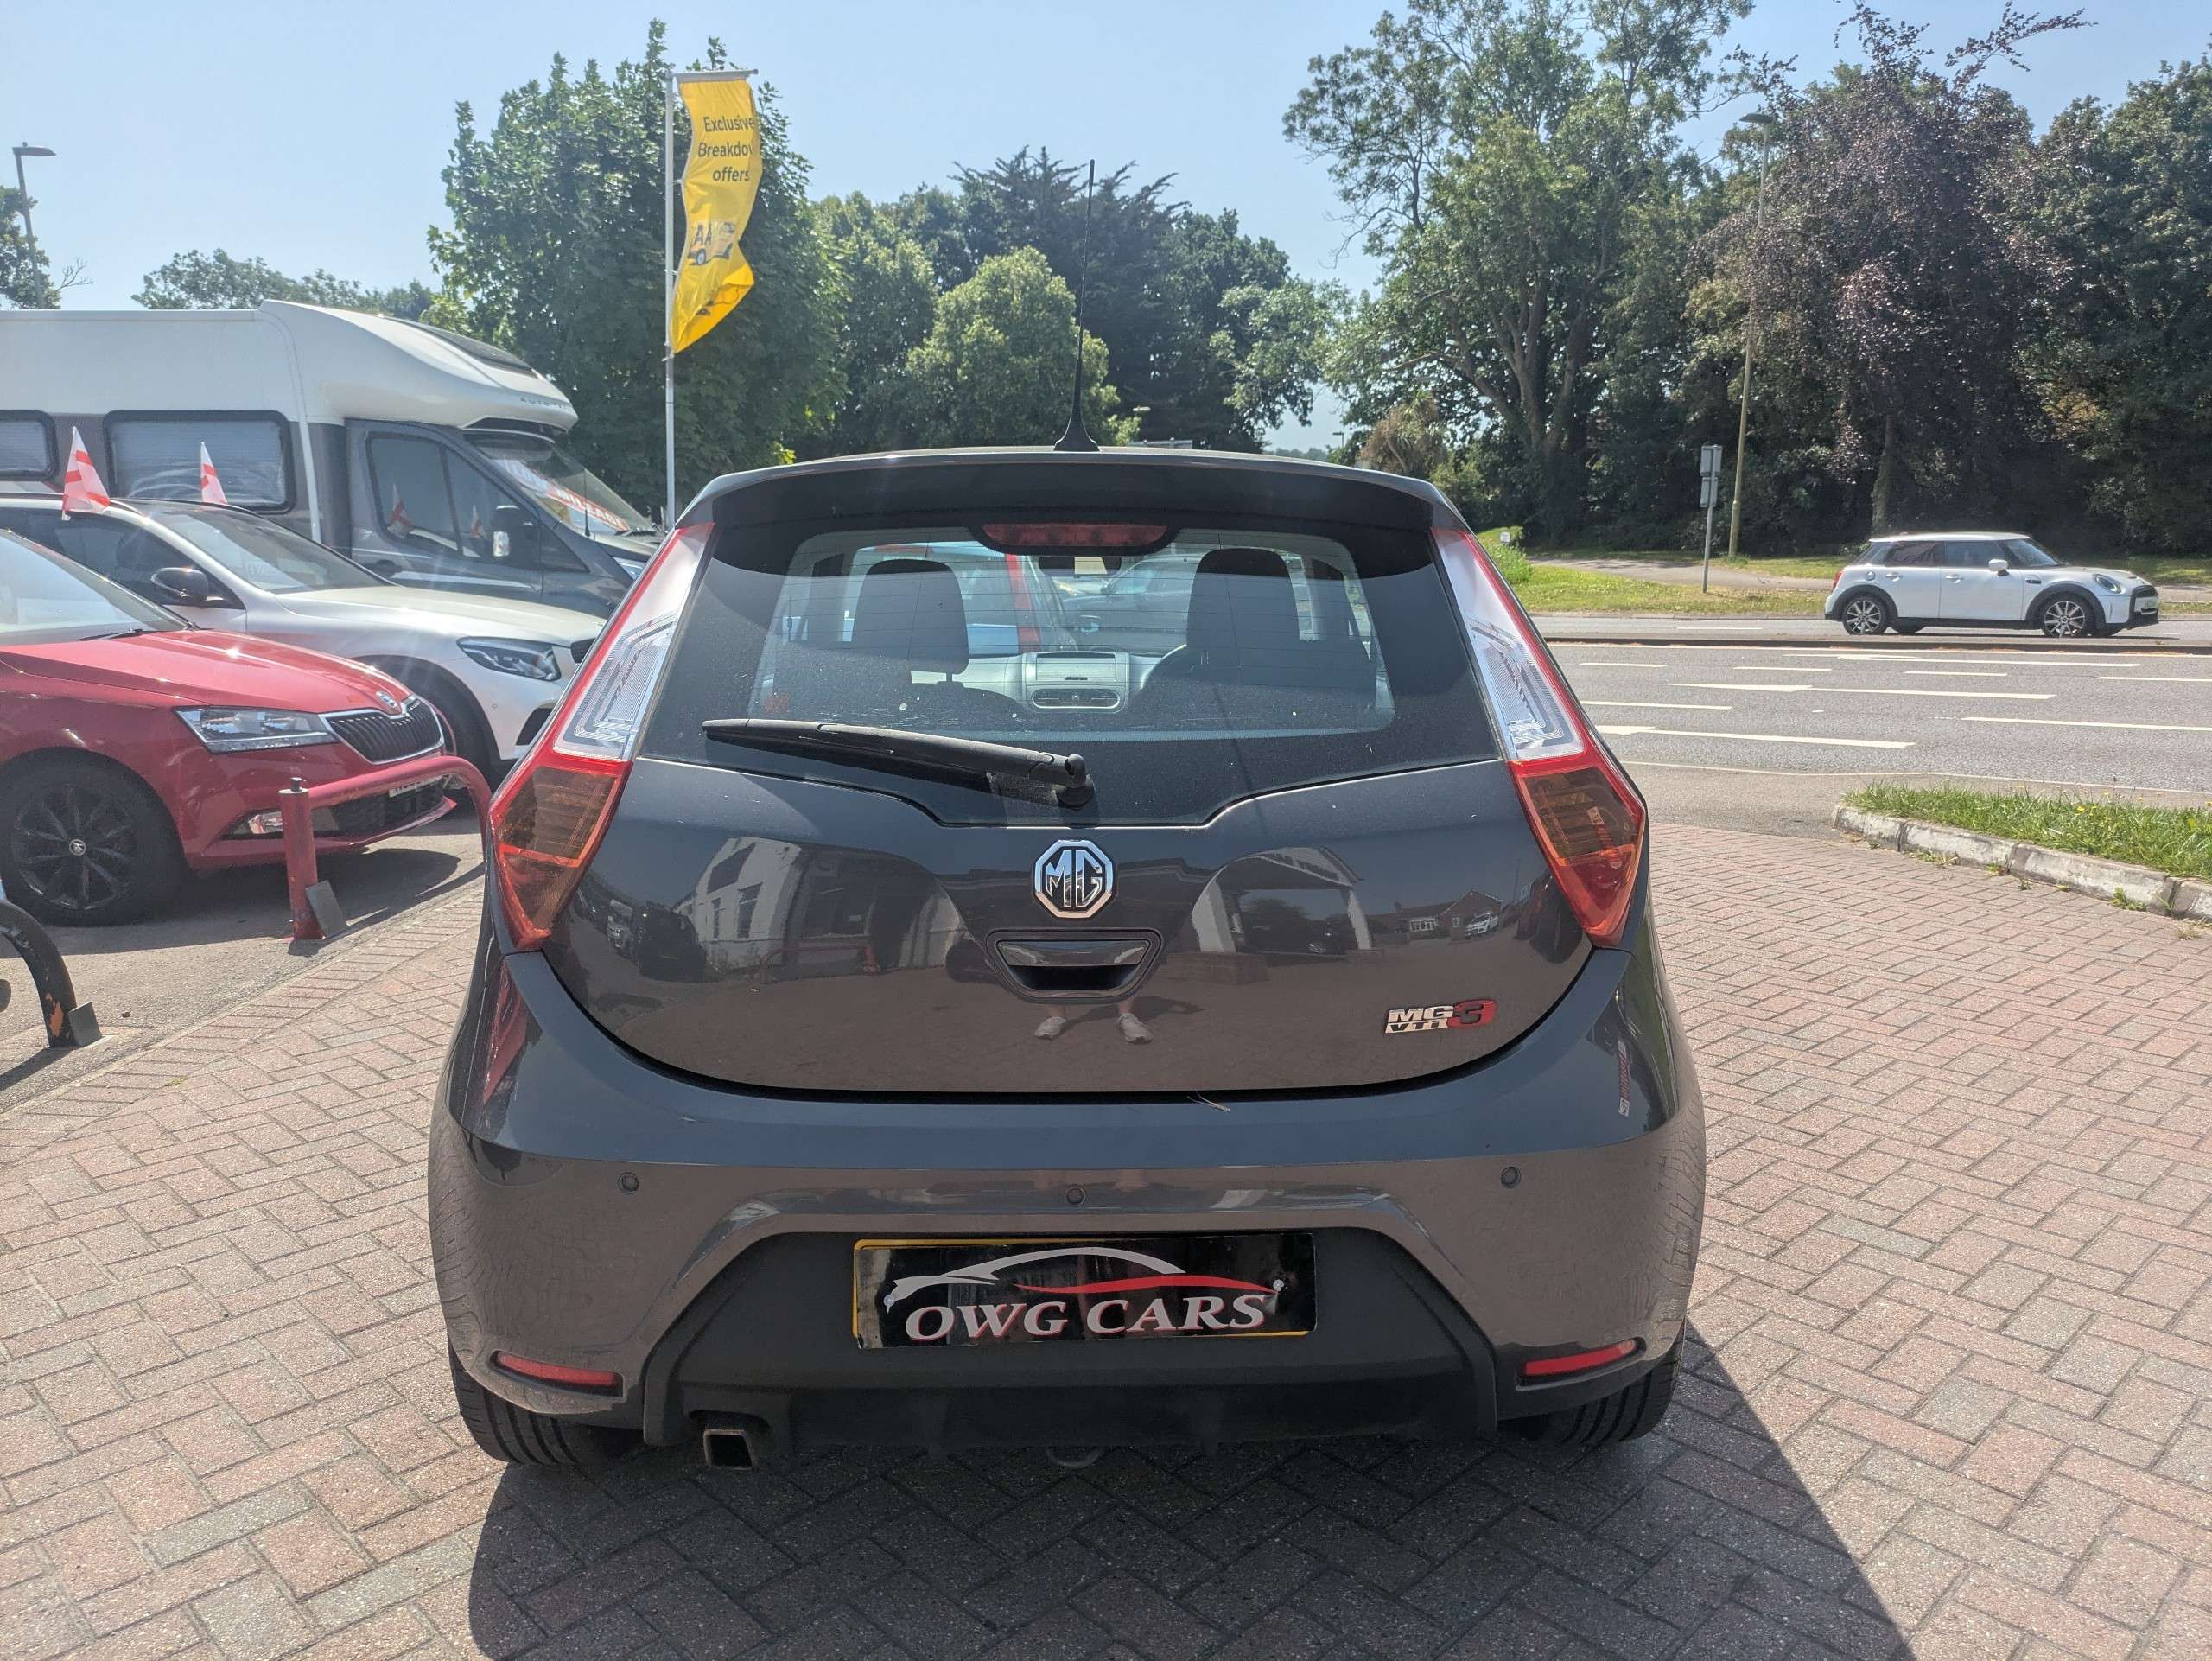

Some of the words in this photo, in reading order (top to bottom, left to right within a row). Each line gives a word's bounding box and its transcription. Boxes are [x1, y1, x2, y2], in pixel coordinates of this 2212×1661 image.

[703, 114, 754, 132] Exclusive
[698, 141, 753, 157] Breakdo
[713, 166, 750, 182] offers
[1045, 849, 1103, 908] MG
[1387, 999, 1498, 1028] MG3
[906, 1301, 1068, 1341] OWG
[1086, 1295, 1268, 1334] CARS
